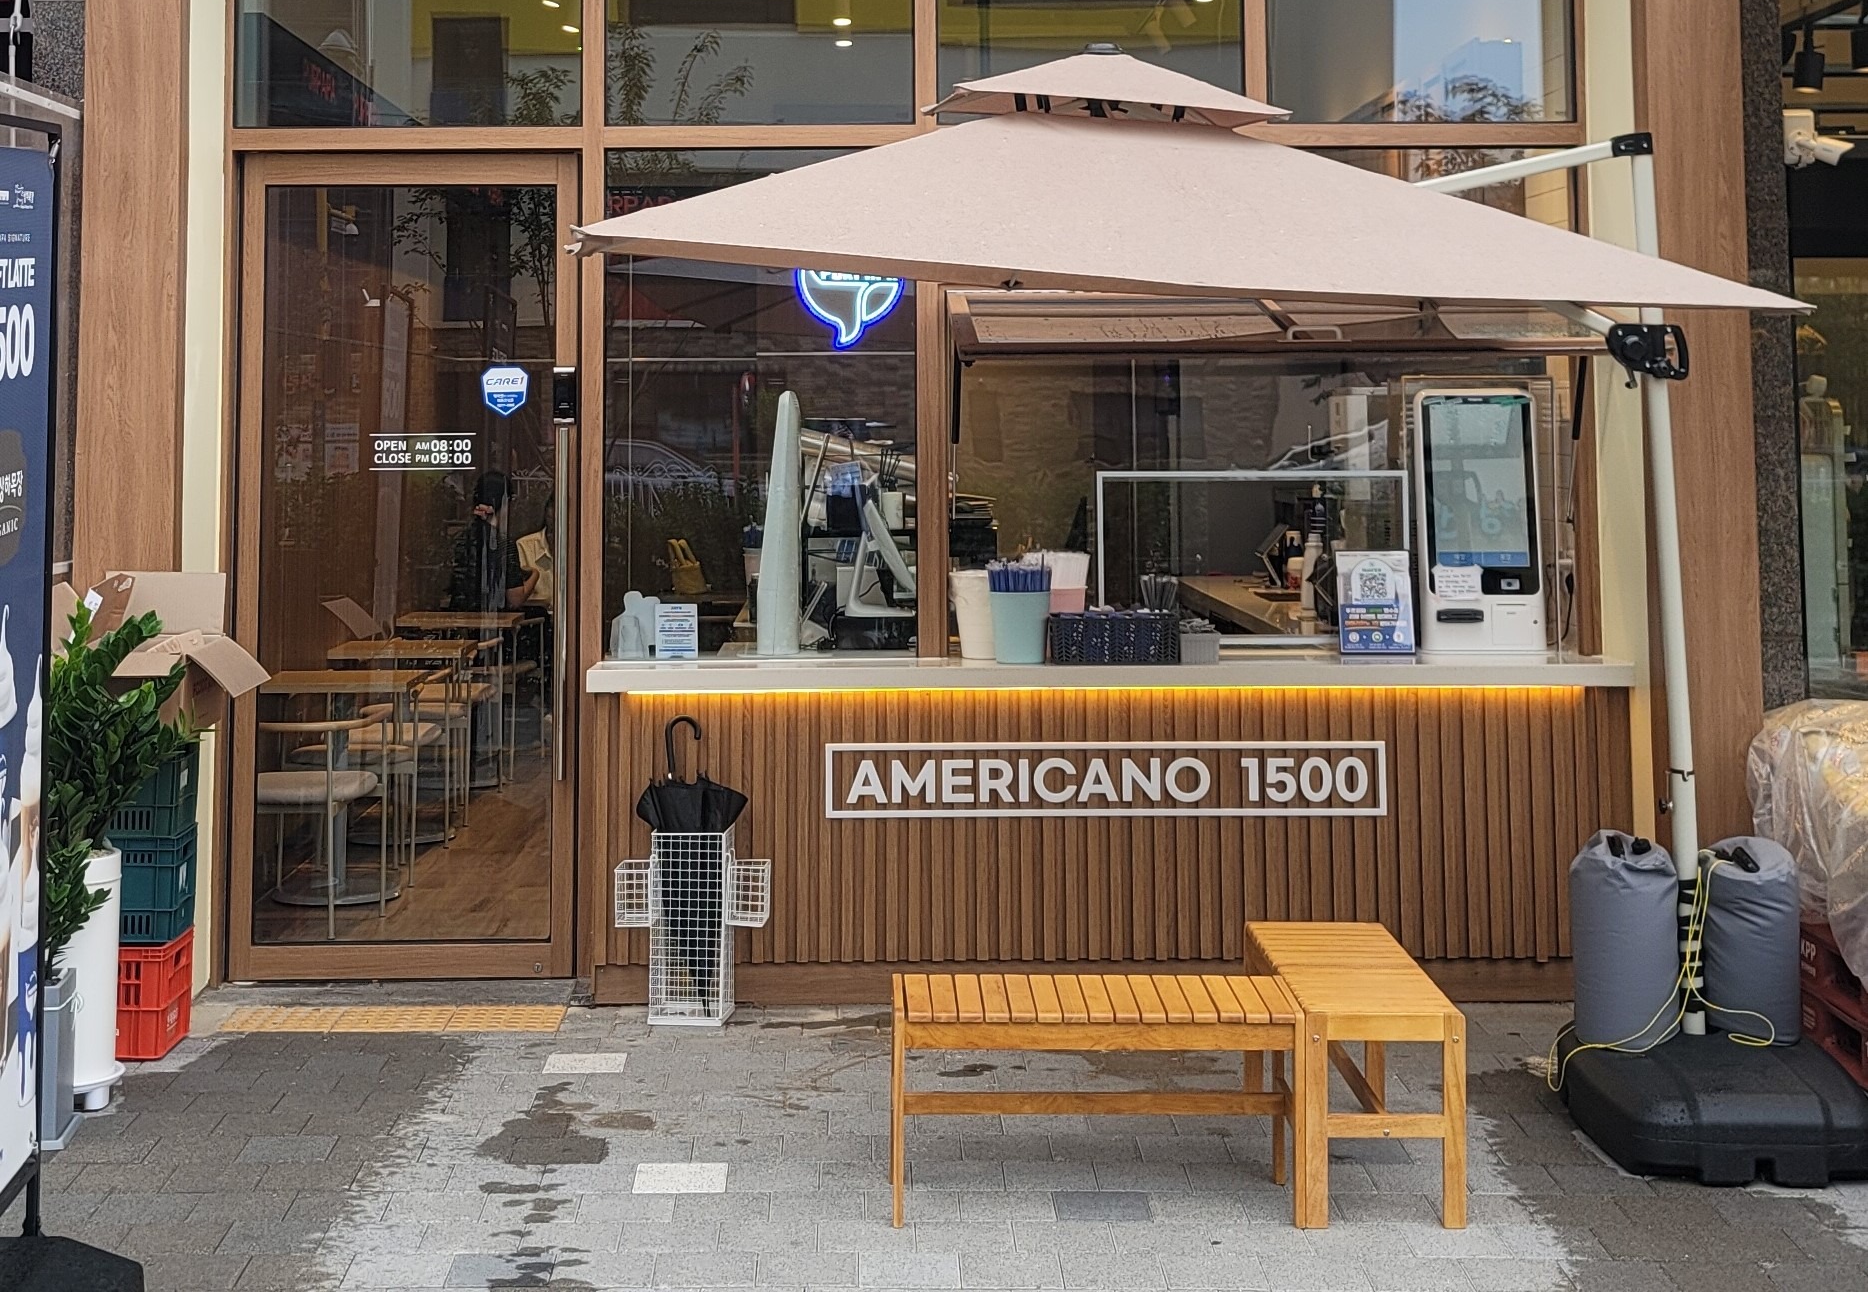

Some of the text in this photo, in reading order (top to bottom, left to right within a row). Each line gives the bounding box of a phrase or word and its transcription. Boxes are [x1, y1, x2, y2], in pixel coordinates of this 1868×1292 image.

[374, 440, 407, 451] OPEN
[374, 452, 412, 464] CLOSE
[0, 517, 19, 537] ANIC
[845, 755, 1369, 805] AMERICANO 1500
